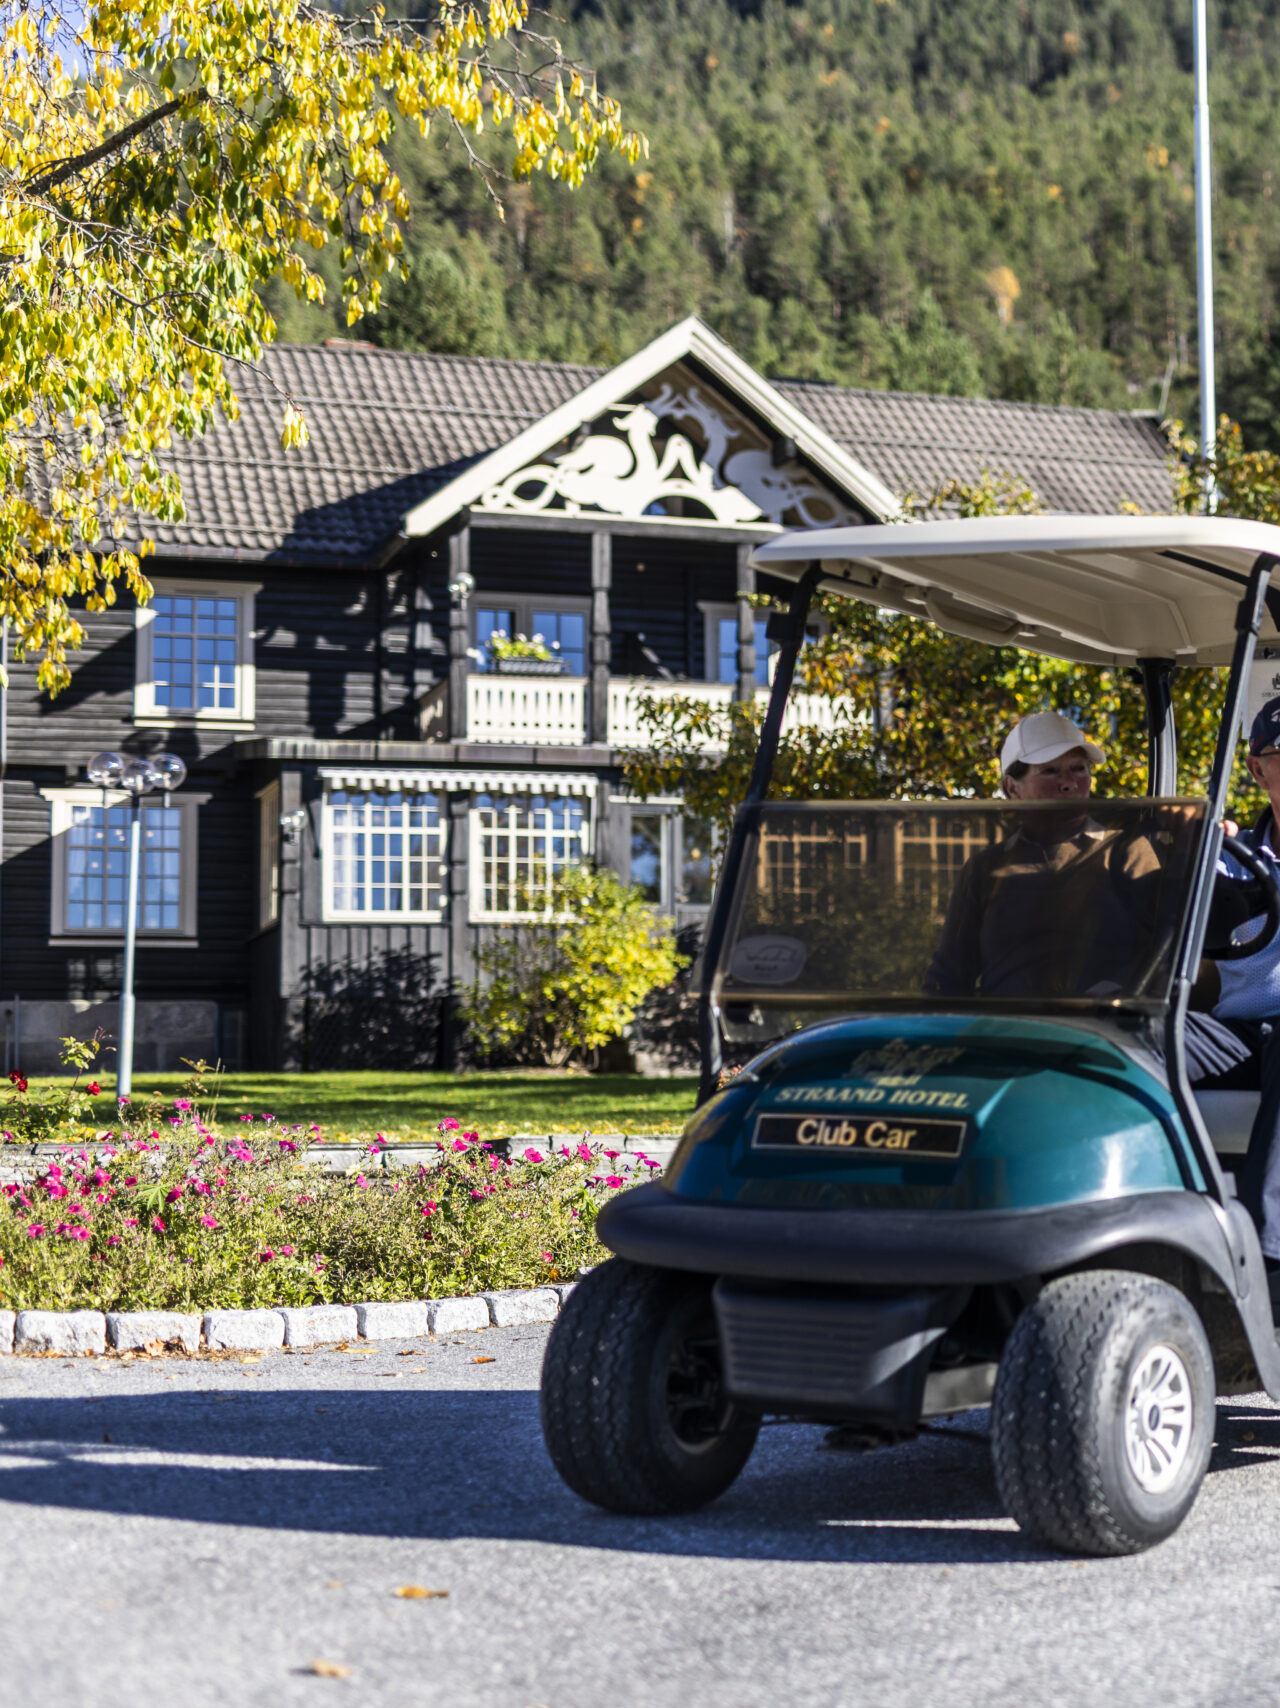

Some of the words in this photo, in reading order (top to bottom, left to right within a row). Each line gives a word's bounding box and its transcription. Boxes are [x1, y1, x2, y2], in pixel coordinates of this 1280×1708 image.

[774, 1087, 885, 1103] STRAAND
[888, 1089, 969, 1109] HOTEL
[796, 1119, 857, 1146] Club
[864, 1121, 916, 1149] Car
